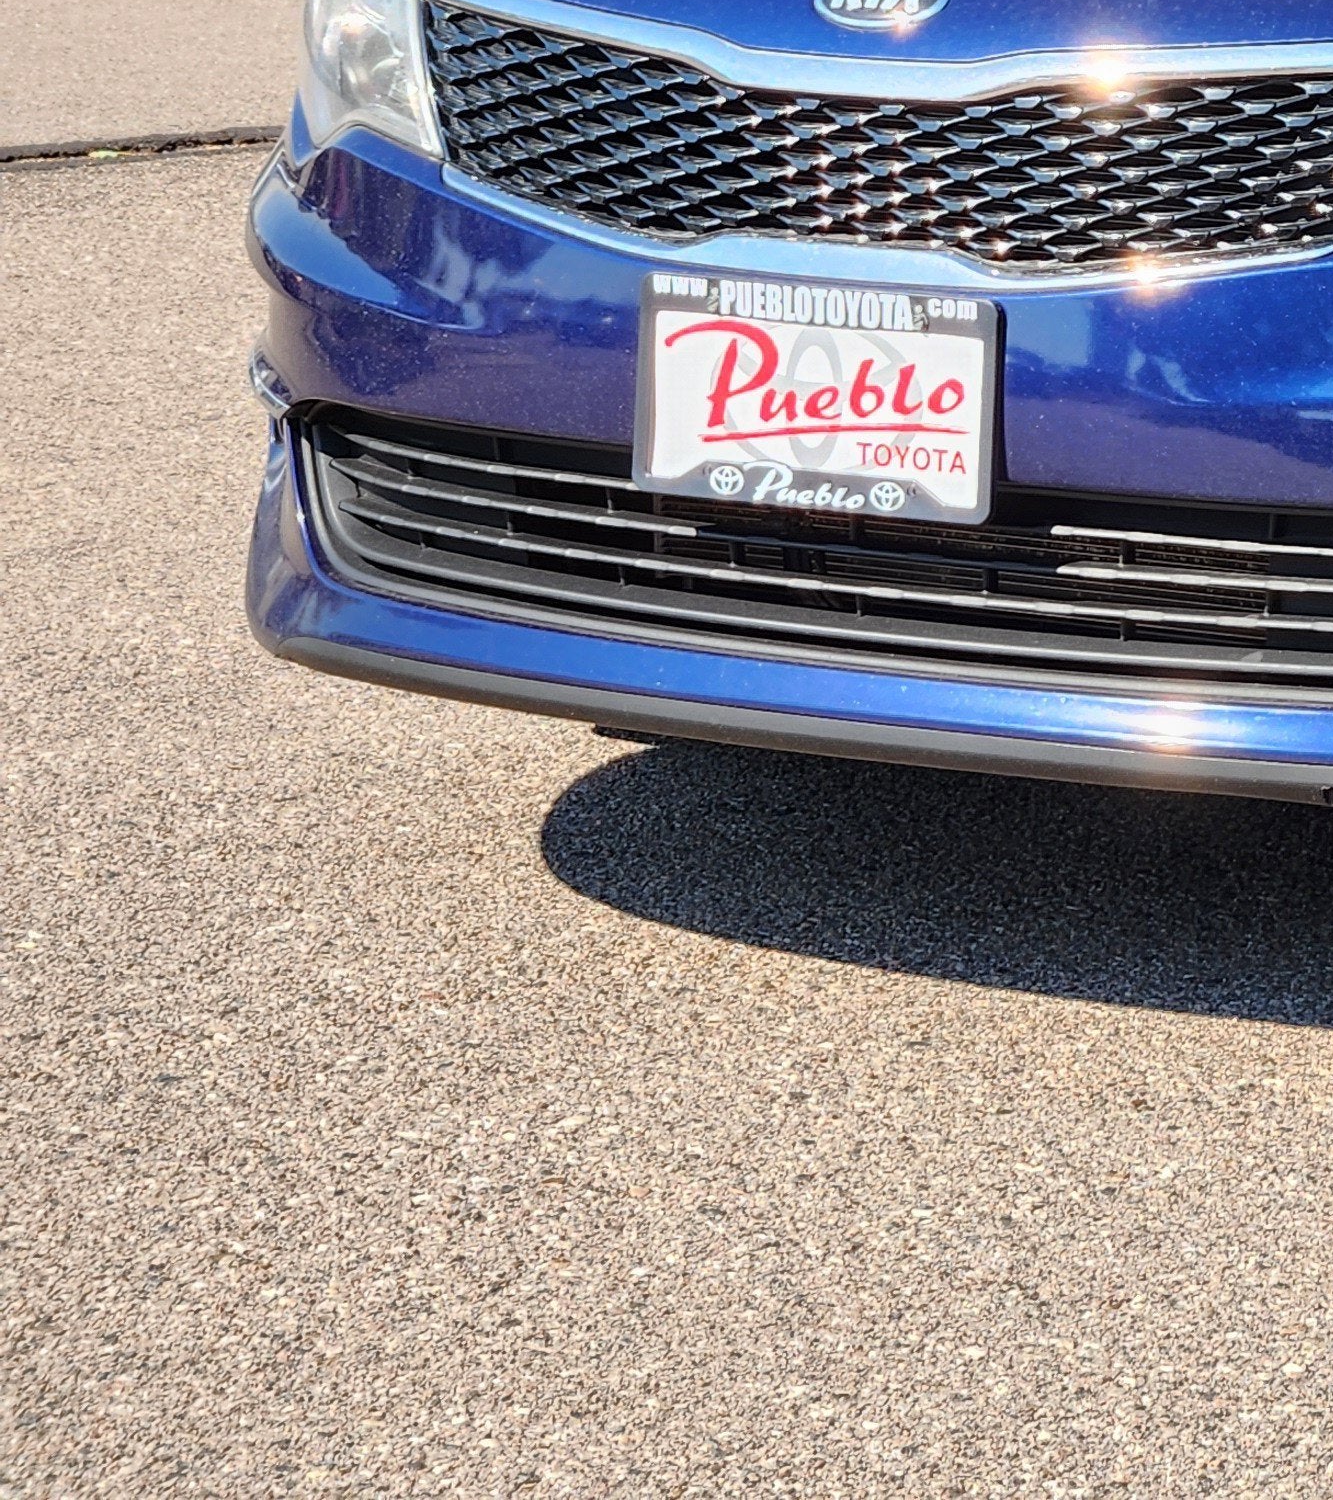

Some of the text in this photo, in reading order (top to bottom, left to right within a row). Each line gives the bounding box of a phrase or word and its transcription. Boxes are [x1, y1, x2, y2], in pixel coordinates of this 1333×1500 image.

[719, 279, 914, 331] PUEBLOTOYOTA
[664, 319, 966, 428] Pueblo
[856, 441, 967, 475] TOYOTA
[742, 459, 866, 510] Pueblo
